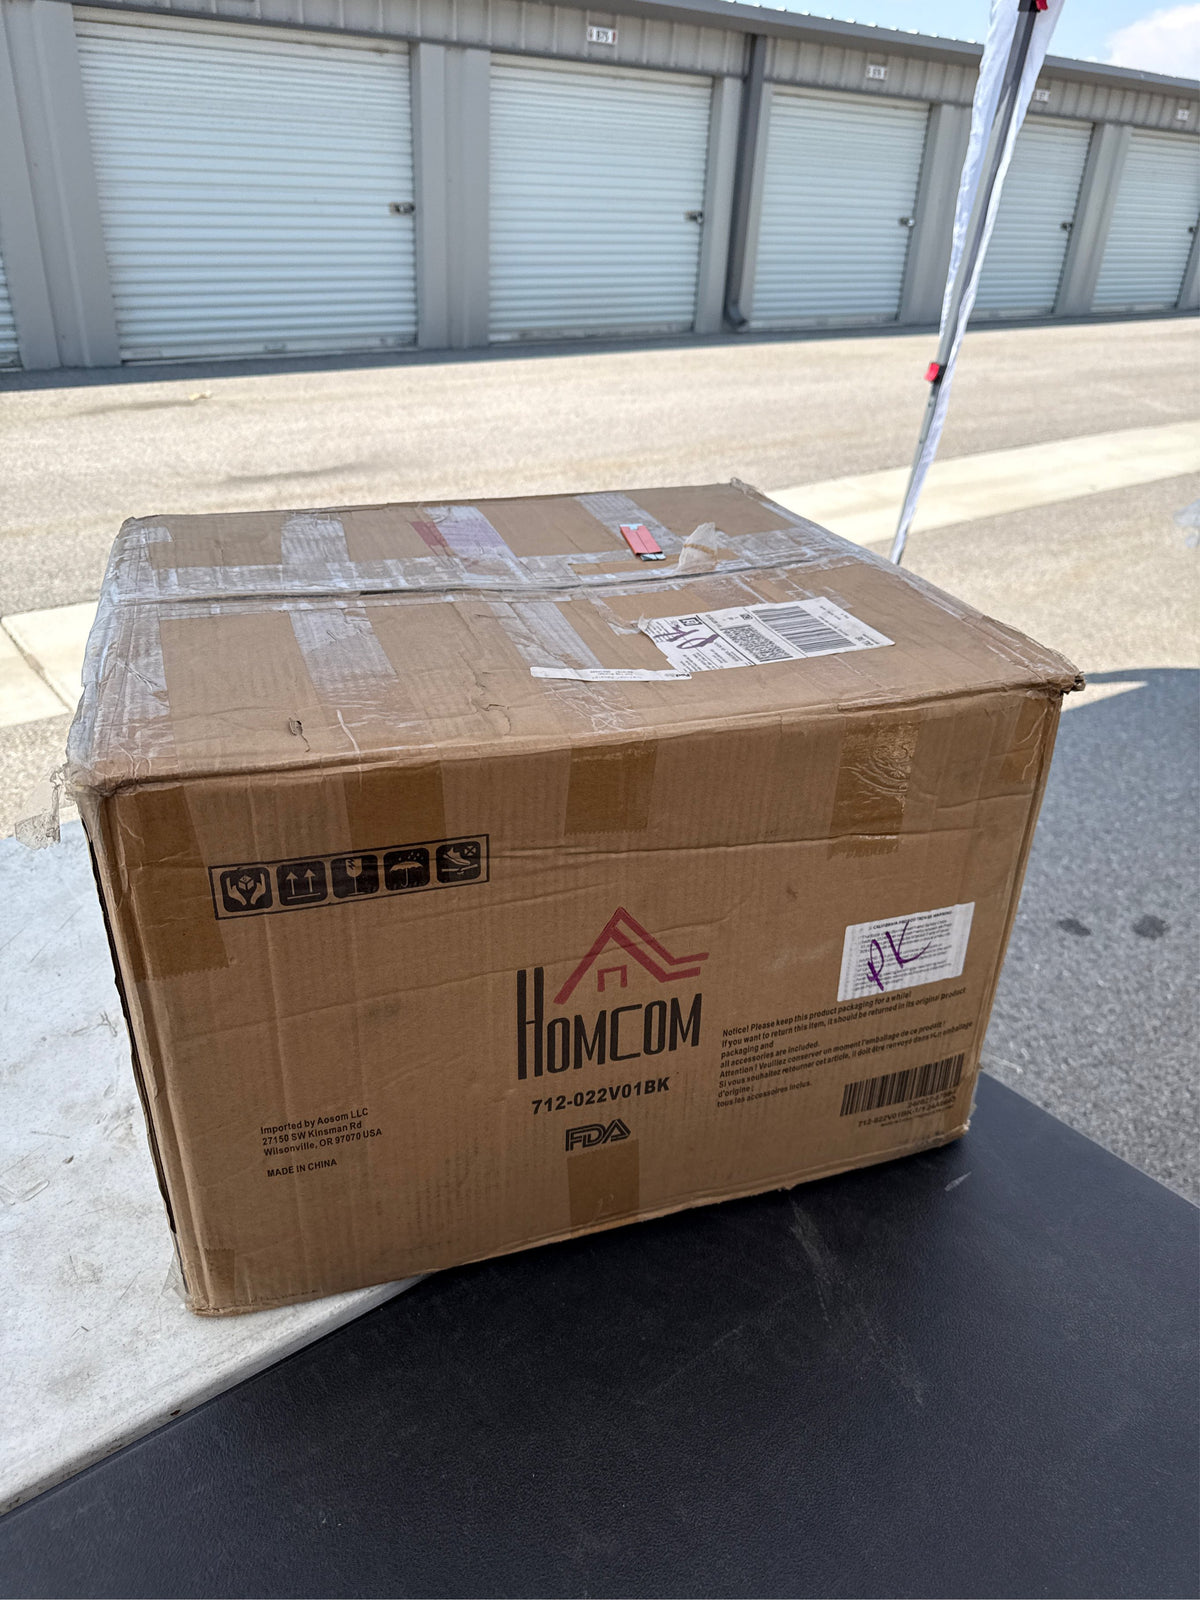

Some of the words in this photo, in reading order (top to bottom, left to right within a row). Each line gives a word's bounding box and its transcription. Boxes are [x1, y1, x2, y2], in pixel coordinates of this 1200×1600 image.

[517, 966, 703, 1080] HOMCOM
[722, 1025, 749, 1037] Notice!
[750, 1020, 775, 1032] Please
[776, 1016, 794, 1027] keep
[794, 1013, 808, 1022] this
[809, 1007, 837, 1022] product
[838, 1000, 874, 1015] packaging
[874, 997, 885, 1005] for
[728, 1036, 742, 1048] you
[744, 1032, 761, 1043] want
[762, 1030, 769, 1039] to
[770, 1026, 793, 1038] return
[794, 1022, 808, 1032] this
[809, 1018, 826, 1030] item,
[834, 1012, 858, 1024] should
[858, 1010, 867, 1019] be
[868, 1003, 898, 1016] returned
[720, 1044, 759, 1060] packaging
[760, 1040, 774, 1049] and
[720, 1060, 730, 1069] all
[730, 1050, 774, 1066] accessories
[775, 1048, 787, 1056] are
[759, 1059, 787, 1070] Veuillez
[823, 1048, 832, 1056] un
[833, 1040, 861, 1053] moment
[531, 1076, 671, 1115] 712-022V01BK
[728, 1078, 746, 1086] vous
[260, 1120, 302, 1135] Imported
[304, 1118, 316, 1130] by
[317, 1112, 349, 1125] Aosom
[350, 1107, 369, 1120] LLC
[262, 1134, 289, 1146] 27150
[291, 1131, 306, 1141] SW
[308, 1124, 348, 1139] Kinsman
[350, 1120, 362, 1130] Rd
[565, 1118, 632, 1152] FDA
[264, 1142, 318, 1157] Wilsonville,
[319, 1136, 334, 1147] OR
[335, 1132, 362, 1144] 97070
[363, 1128, 382, 1139] USA
[266, 1166, 295, 1178] MADE
[296, 1164, 306, 1174] IN
[308, 1158, 338, 1172] CHINA
